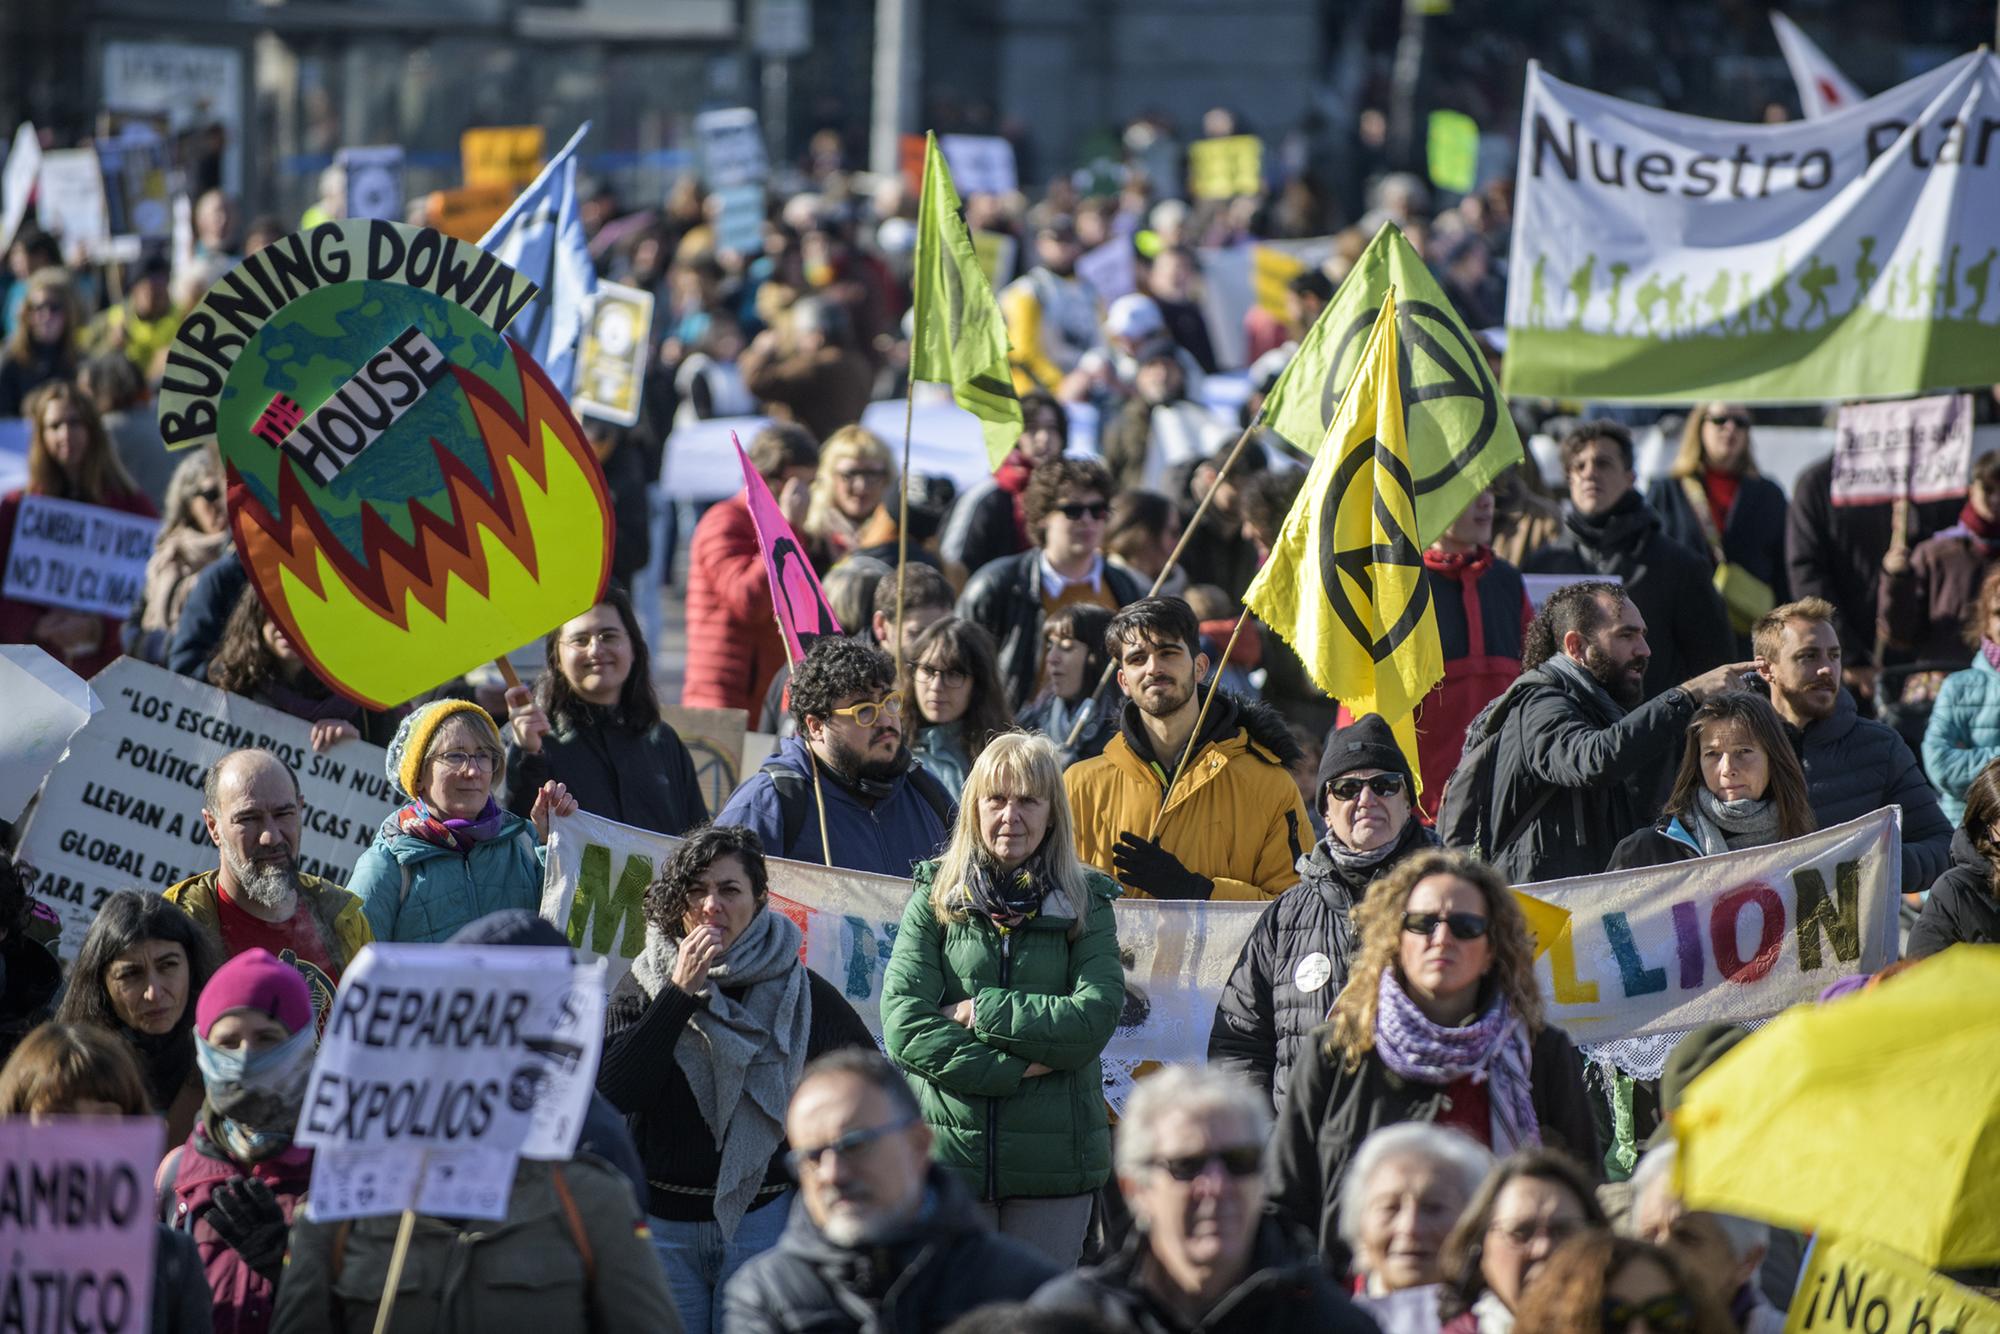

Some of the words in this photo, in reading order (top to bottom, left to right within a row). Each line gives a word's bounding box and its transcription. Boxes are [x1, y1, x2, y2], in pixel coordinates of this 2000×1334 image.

[1531, 114, 1833, 200] Nuestro
[160, 221, 351, 445] BURNING
[368, 218, 541, 334] DOWN
[255, 393, 305, 449] THE
[279, 325, 451, 488] HOUSE
[13, 554, 42, 590] NO
[45, 559, 75, 596] TU
[176, 711, 303, 771] ESCENARIOS
[309, 754, 346, 786] SIN
[80, 782, 163, 829] LLEVAN
[166, 812, 184, 837] A
[60, 829, 146, 879] GLOBAL
[149, 860, 181, 889] DE
[333, 981, 530, 1048] REPARAR
[306, 1073, 500, 1140] EXPOLIOS
[1805, 1262, 1890, 1334] ¡No
